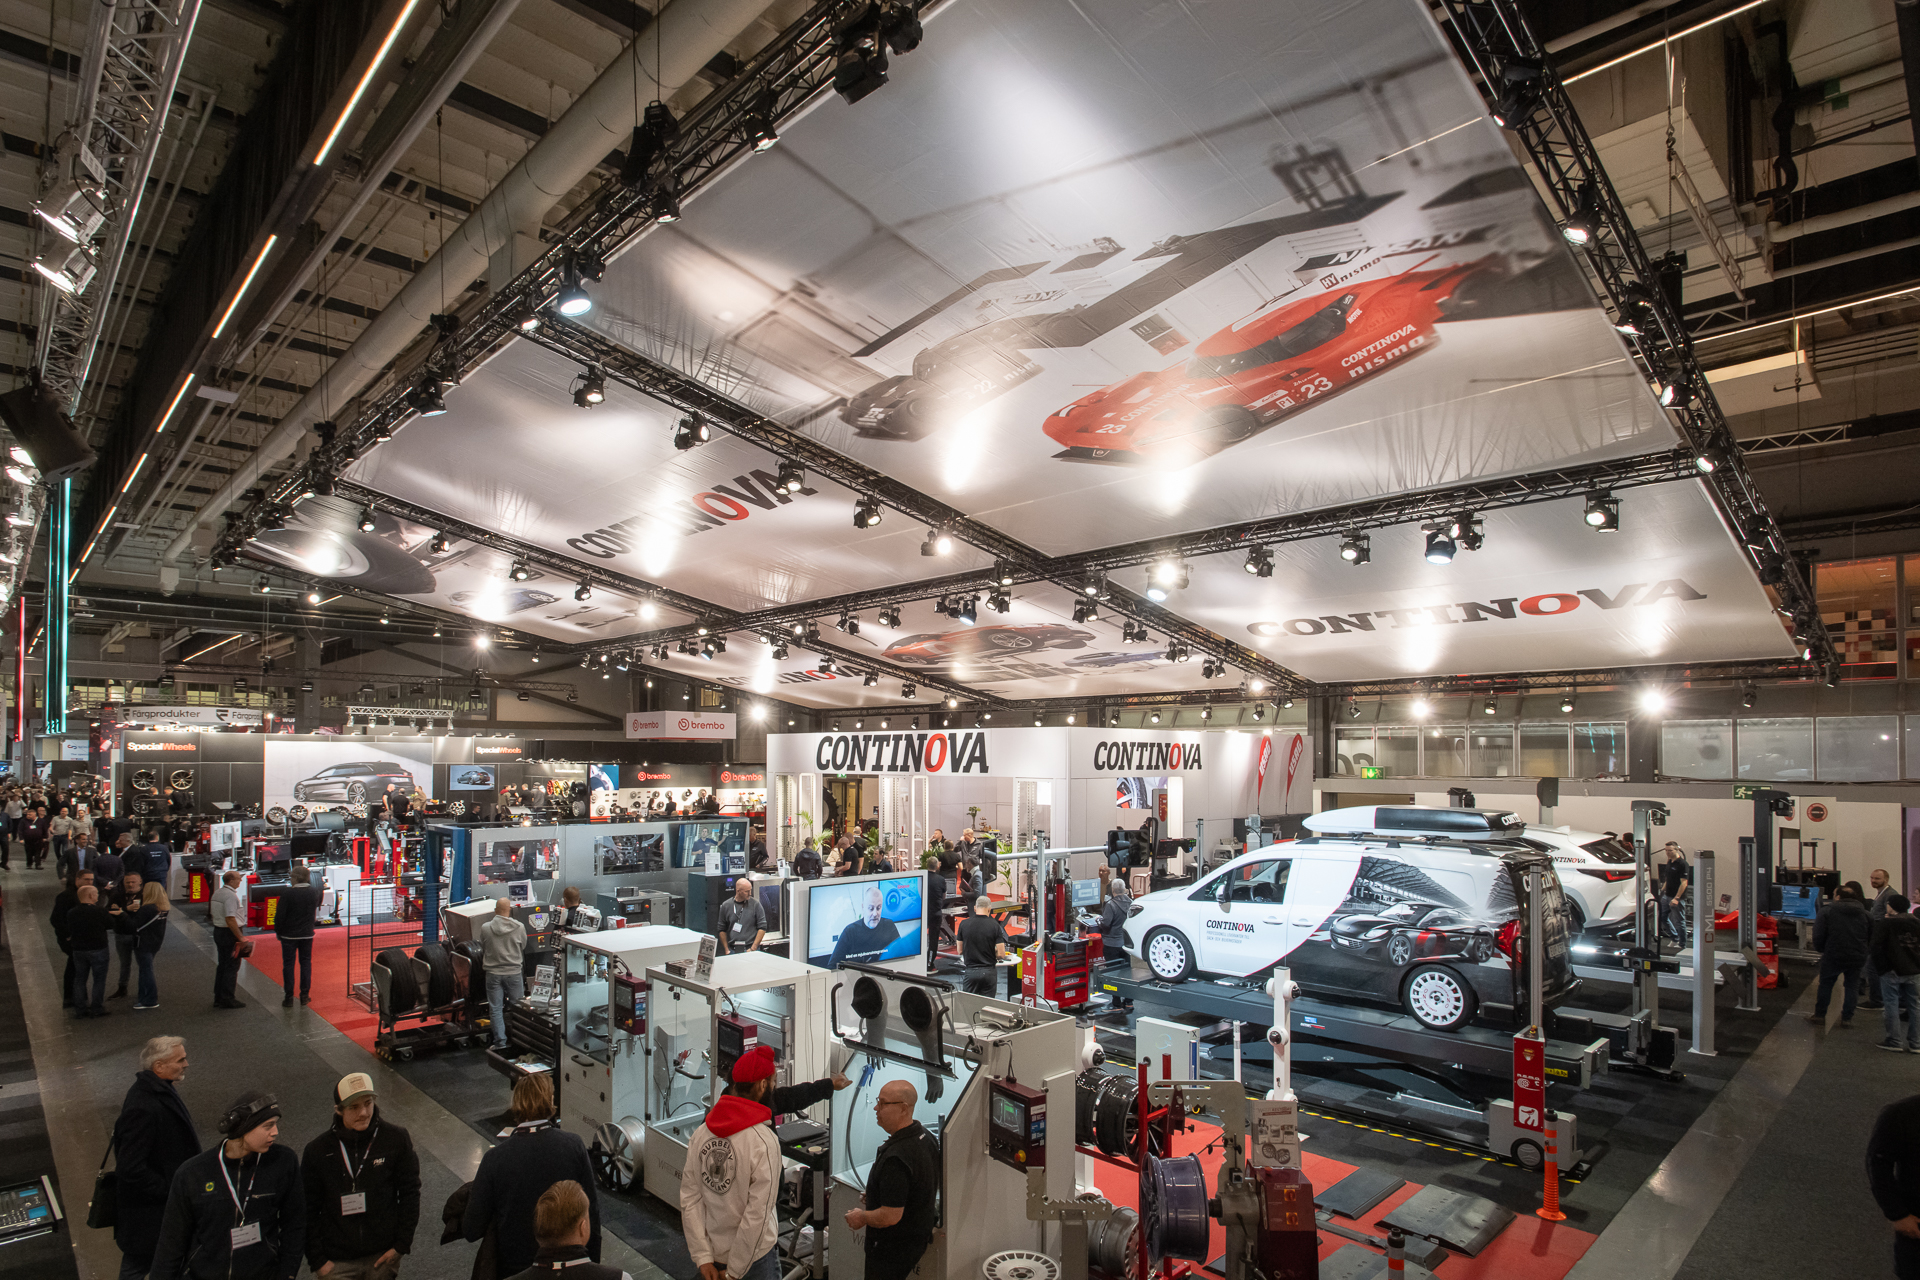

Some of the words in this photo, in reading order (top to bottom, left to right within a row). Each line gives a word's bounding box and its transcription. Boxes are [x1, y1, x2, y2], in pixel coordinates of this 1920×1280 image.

[1321, 275, 1339, 289] HY
[1339, 256, 1381, 283] nismo
[1347, 308, 1363, 324] MOTUL
[1341, 324, 1417, 367] CONTINOVA
[1349, 335, 1425, 378] nismo
[1003, 361, 1038, 382] nism
[973, 379, 998, 395] 22
[1300, 377, 1333, 399] 23
[1280, 397, 1294, 408] P1
[1095, 424, 1127, 434] 23
[1246, 578, 1707, 638] CONTINOVA
[132, 709, 201, 719] Färgprodukter
[639, 721, 660, 730] brembo
[691, 721, 726, 731] brembo
[127, 742, 196, 751] SpecialWheels
[476, 746, 522, 754] SpecialWheels
[816, 732, 989, 774] CONTINOVA
[1094, 741, 1202, 771] CONTINOVA
[1259, 740, 1271, 777] USAG
[1289, 739, 1302, 776] USAG
[646, 772, 671, 780] brembo
[732, 773, 763, 782] brembo
[1706, 866, 1713, 879] P4
[1206, 919, 1255, 933] CONTINOVA
[1704, 908, 1715, 944] CML
